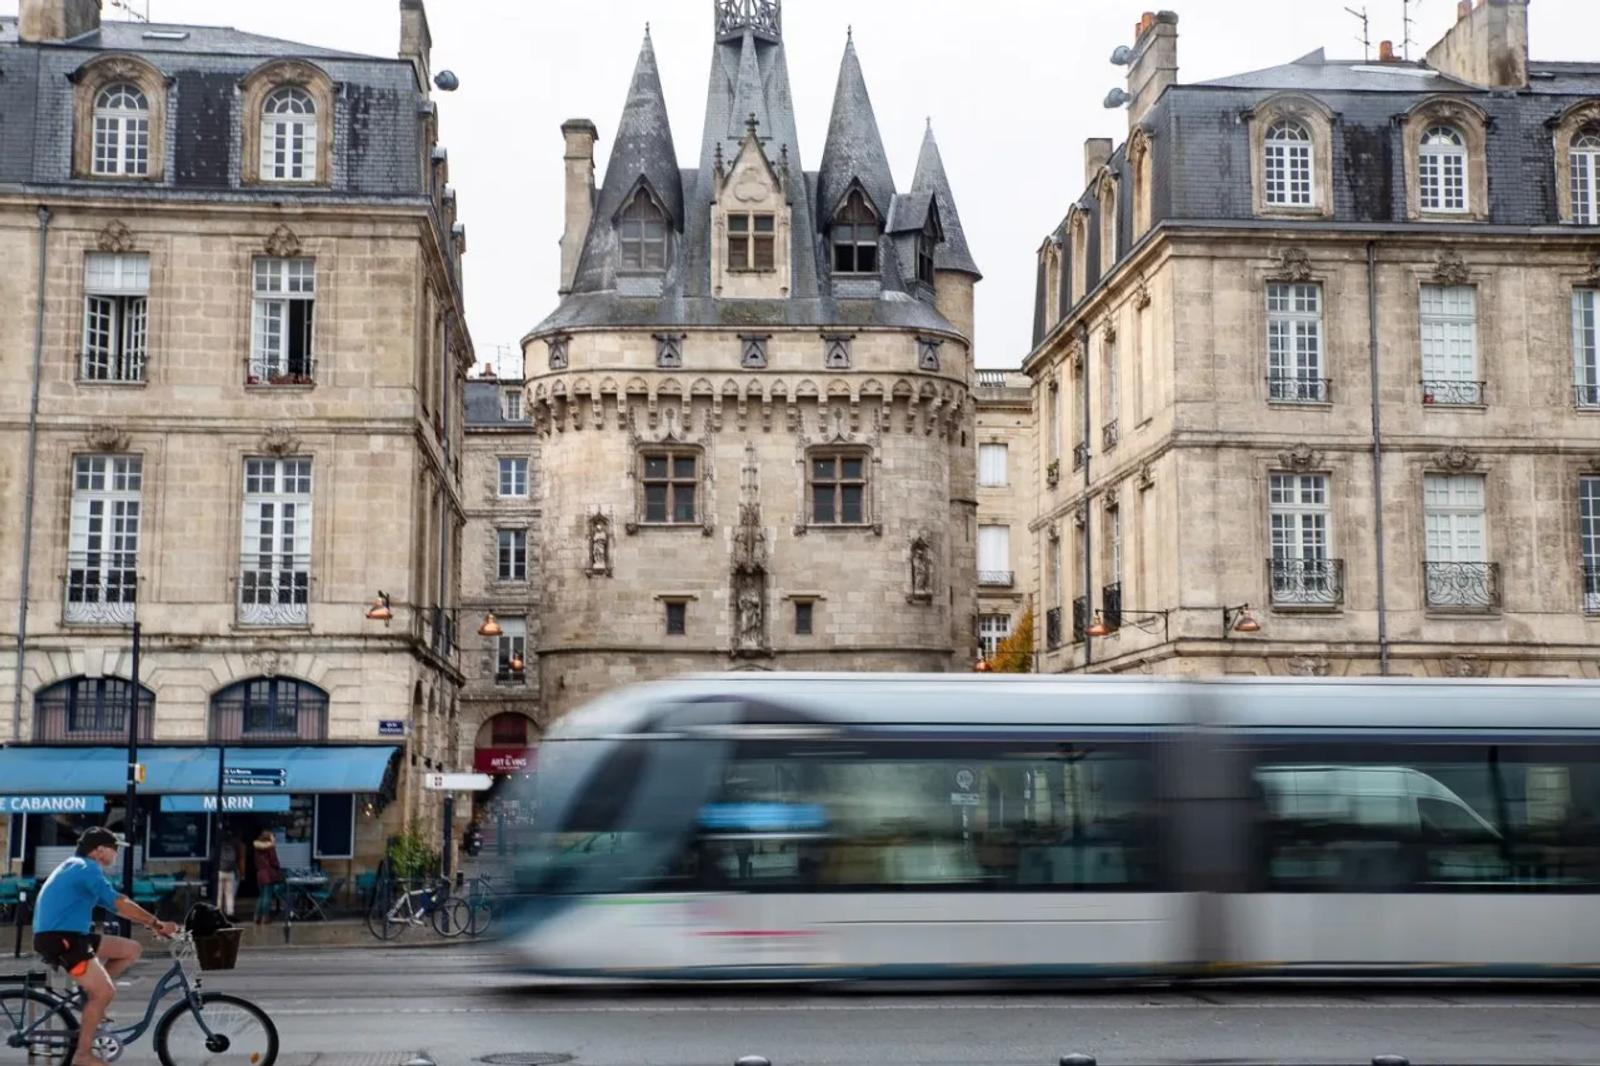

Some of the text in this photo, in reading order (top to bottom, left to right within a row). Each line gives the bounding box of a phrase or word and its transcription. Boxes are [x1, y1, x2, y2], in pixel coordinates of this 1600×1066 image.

[491, 758, 504, 767] ART
[511, 758, 527, 767] VINS
[11, 797, 86, 810] CABANON
